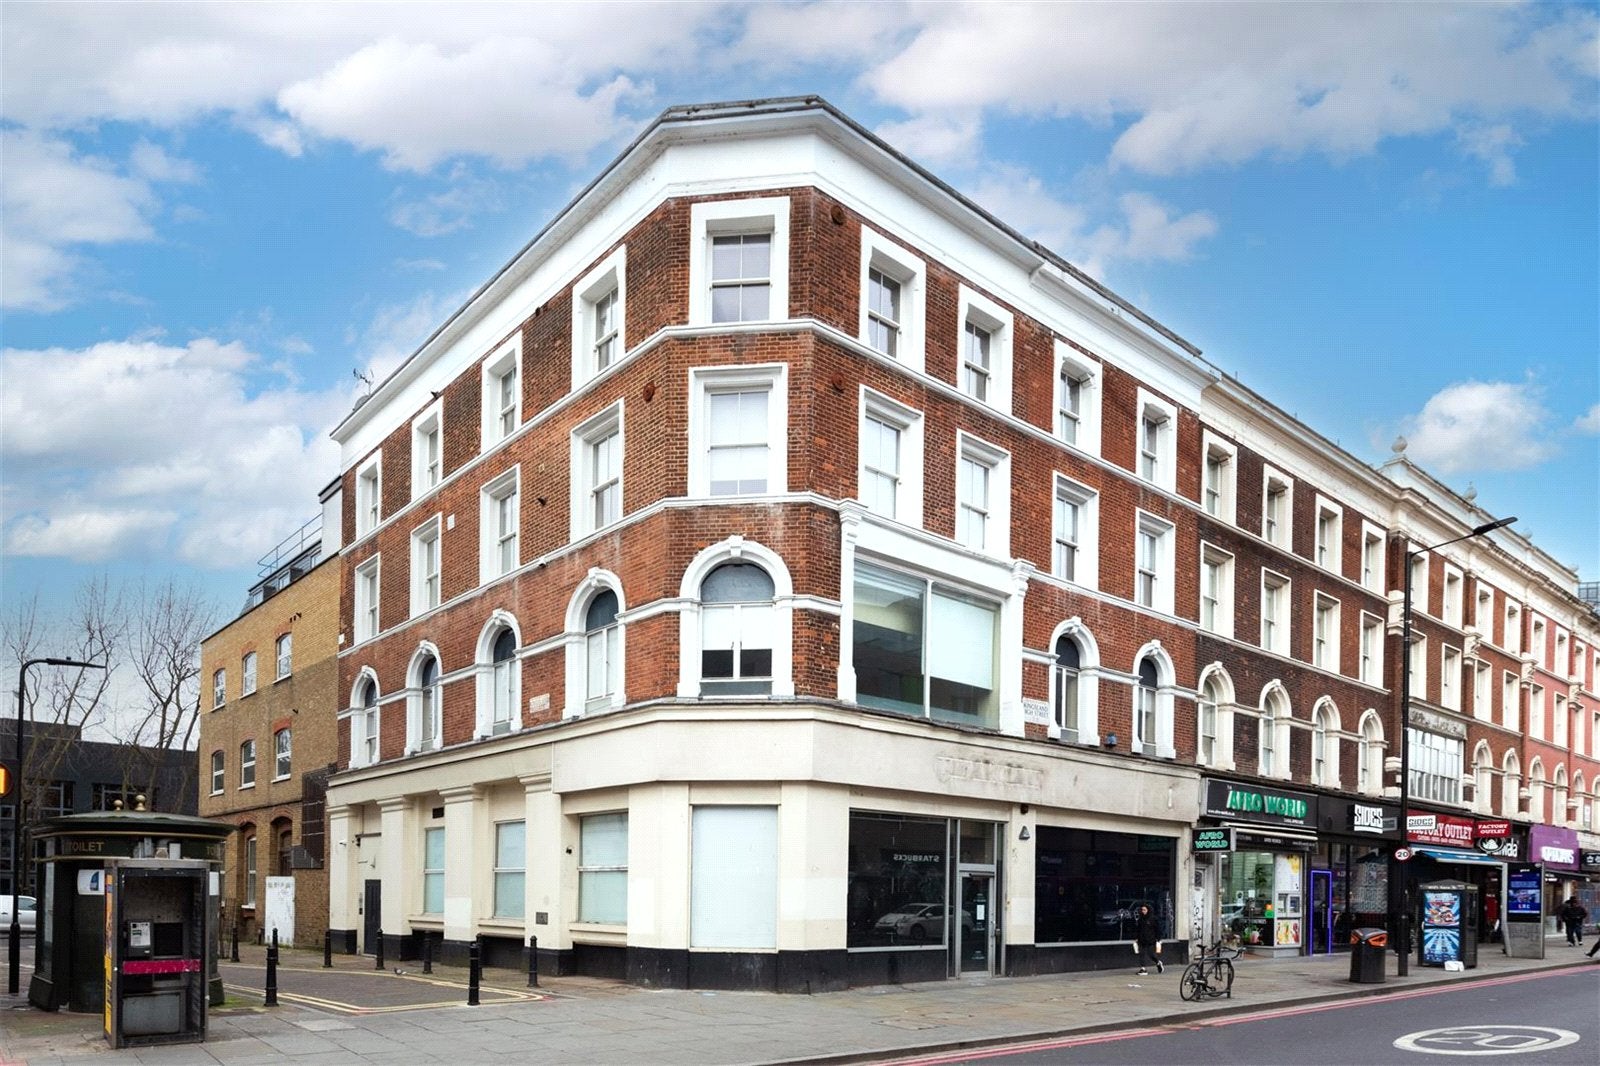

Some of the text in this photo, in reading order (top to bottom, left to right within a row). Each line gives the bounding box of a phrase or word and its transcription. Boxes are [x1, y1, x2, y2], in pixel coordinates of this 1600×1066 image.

[1226, 790, 1308, 818] AFRO WORLD
[1354, 804, 1383, 828] SIDES
[1199, 831, 1224, 840] AFRO
[1445, 824, 1473, 840] OUTLET
[1194, 840, 1229, 848] WORLD
[1419, 1030, 1550, 1049] 20
